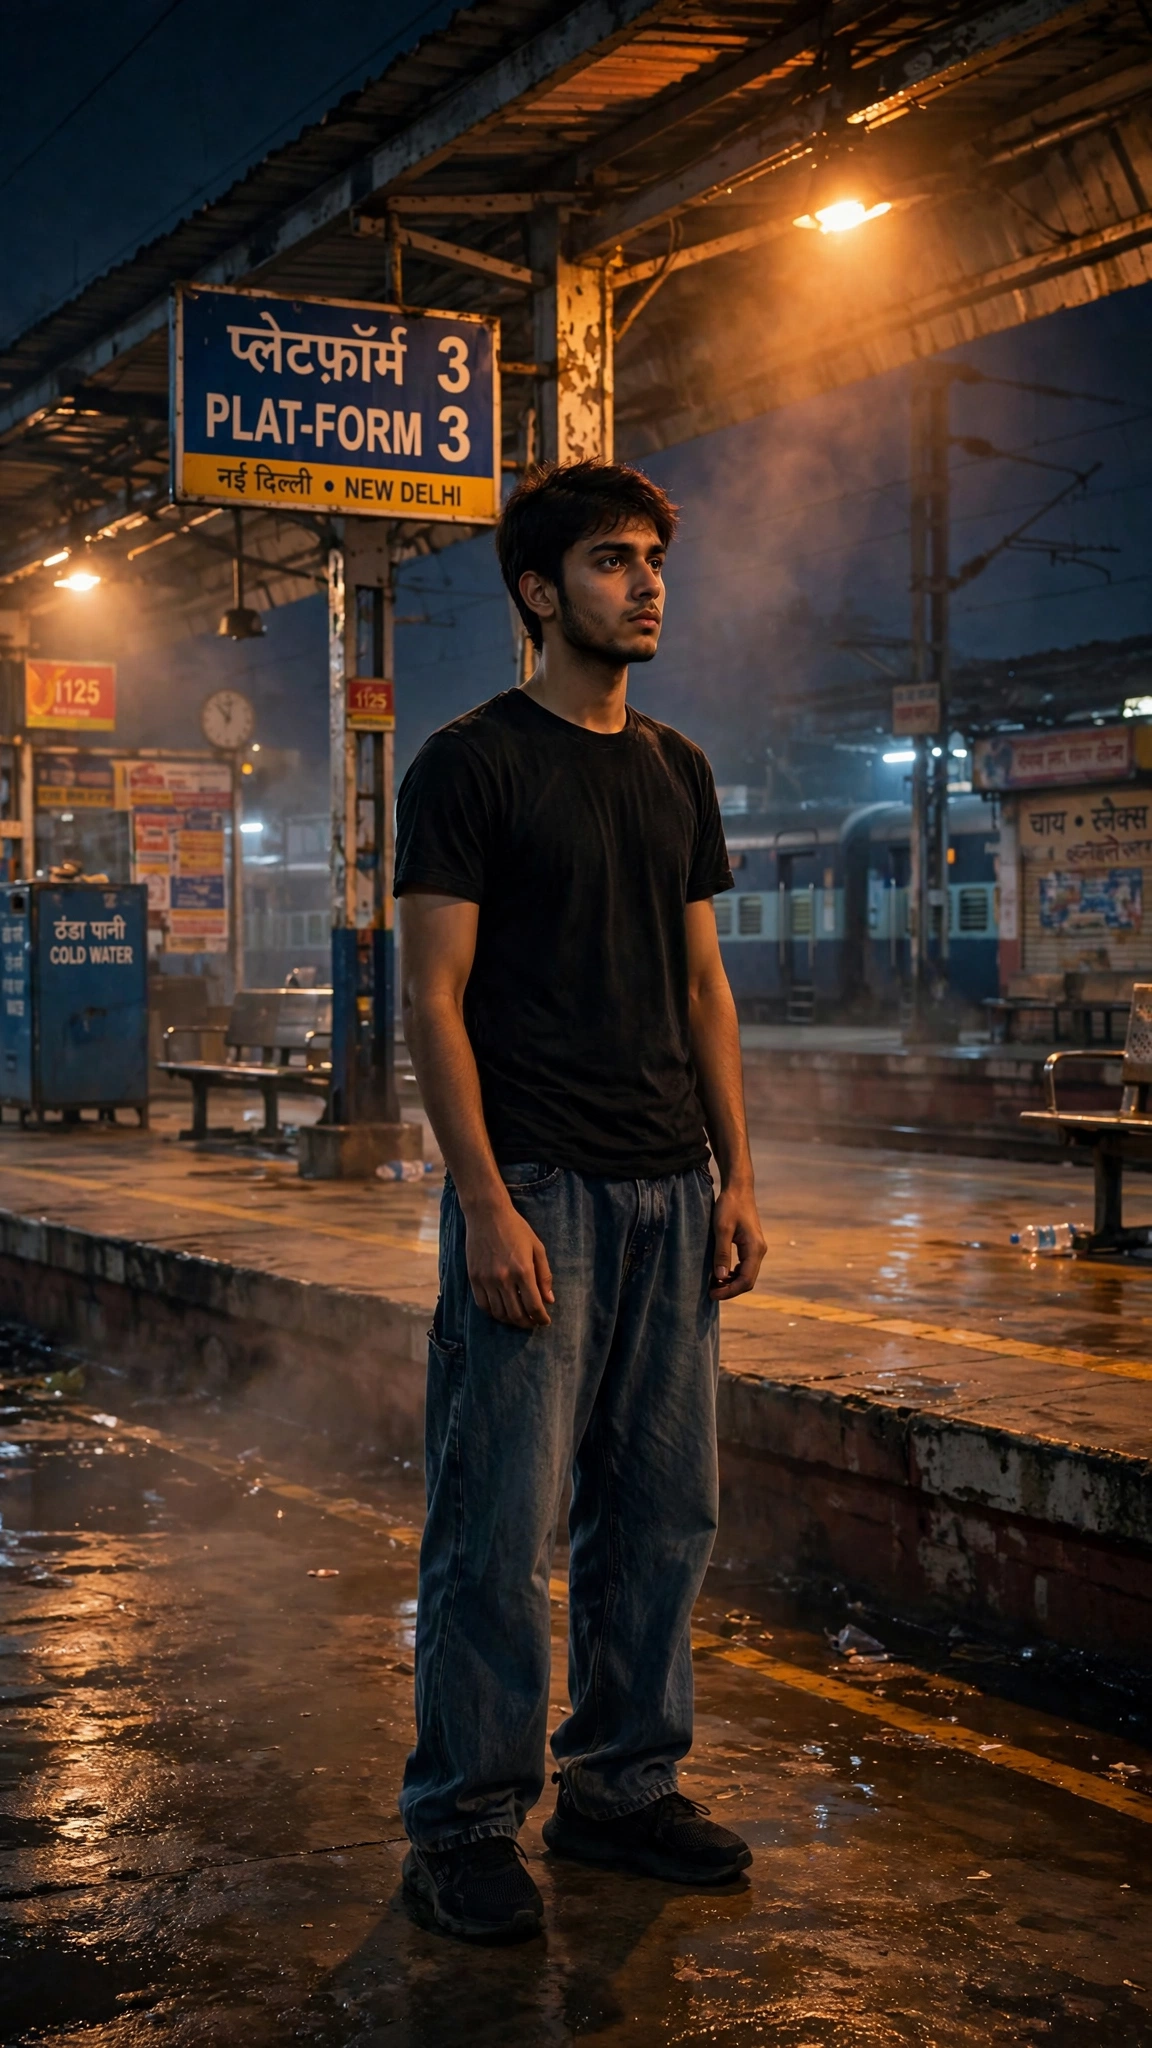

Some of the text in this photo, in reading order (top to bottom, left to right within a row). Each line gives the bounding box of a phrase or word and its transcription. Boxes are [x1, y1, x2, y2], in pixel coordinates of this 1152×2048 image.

[226, 311, 471, 393] प्लेटफ़ॉर्म 3
[206, 392, 471, 462] PLAT-FORM 3
[216, 462, 313, 495] नई दिल्ली
[345, 477, 461, 506] NEW DELHI
[1028, 811, 1067, 836] चाय
[53, 916, 86, 940] ठंडा
[90, 915, 126, 940] पानी
[50, 946, 133, 964] COLD WATER
